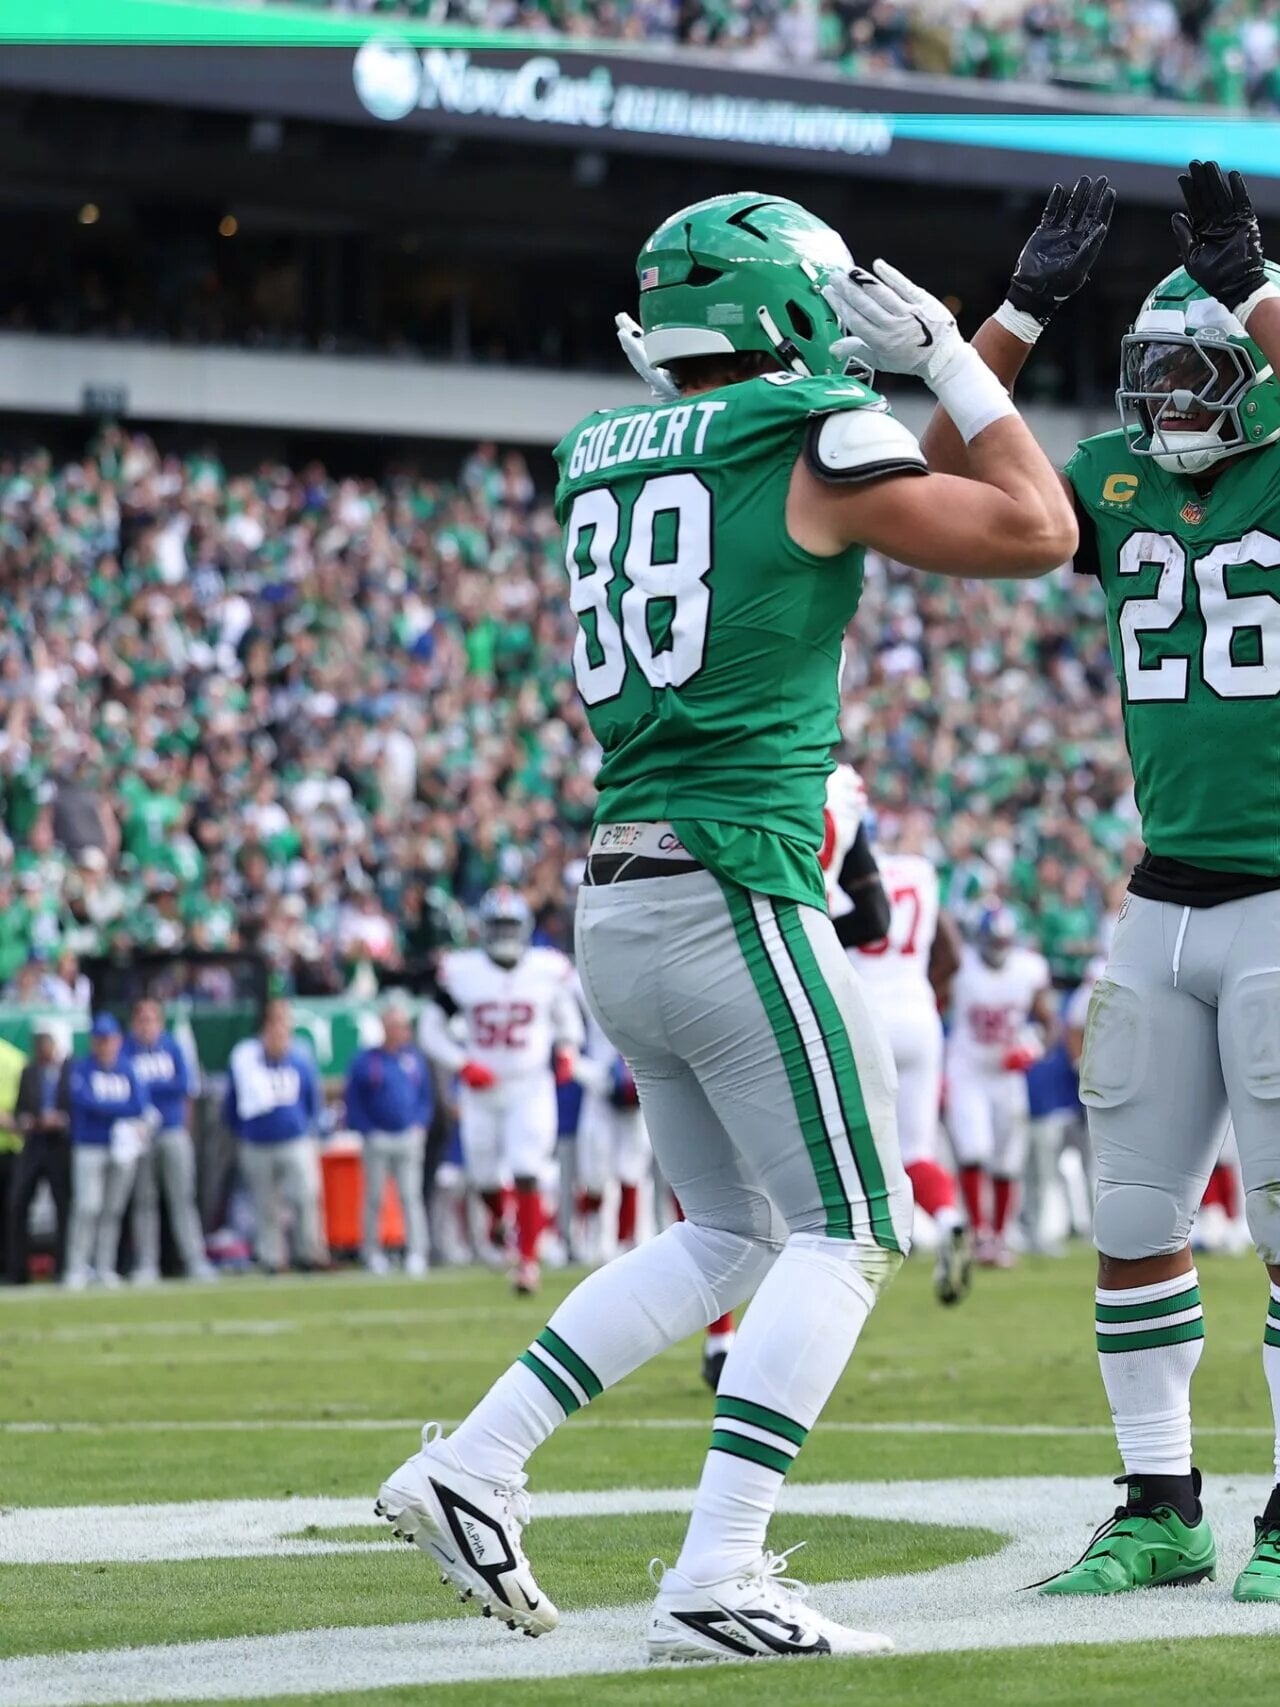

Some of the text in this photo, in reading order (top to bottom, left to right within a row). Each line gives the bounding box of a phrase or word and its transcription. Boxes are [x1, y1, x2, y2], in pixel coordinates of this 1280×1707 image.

[568, 401, 727, 479] GOEDERT
[1102, 473, 1139, 502] C
[564, 472, 713, 708] 88
[857, 886, 918, 955] 7
[472, 1002, 535, 1048] 52
[463, 1521, 486, 1560] ALPHA
